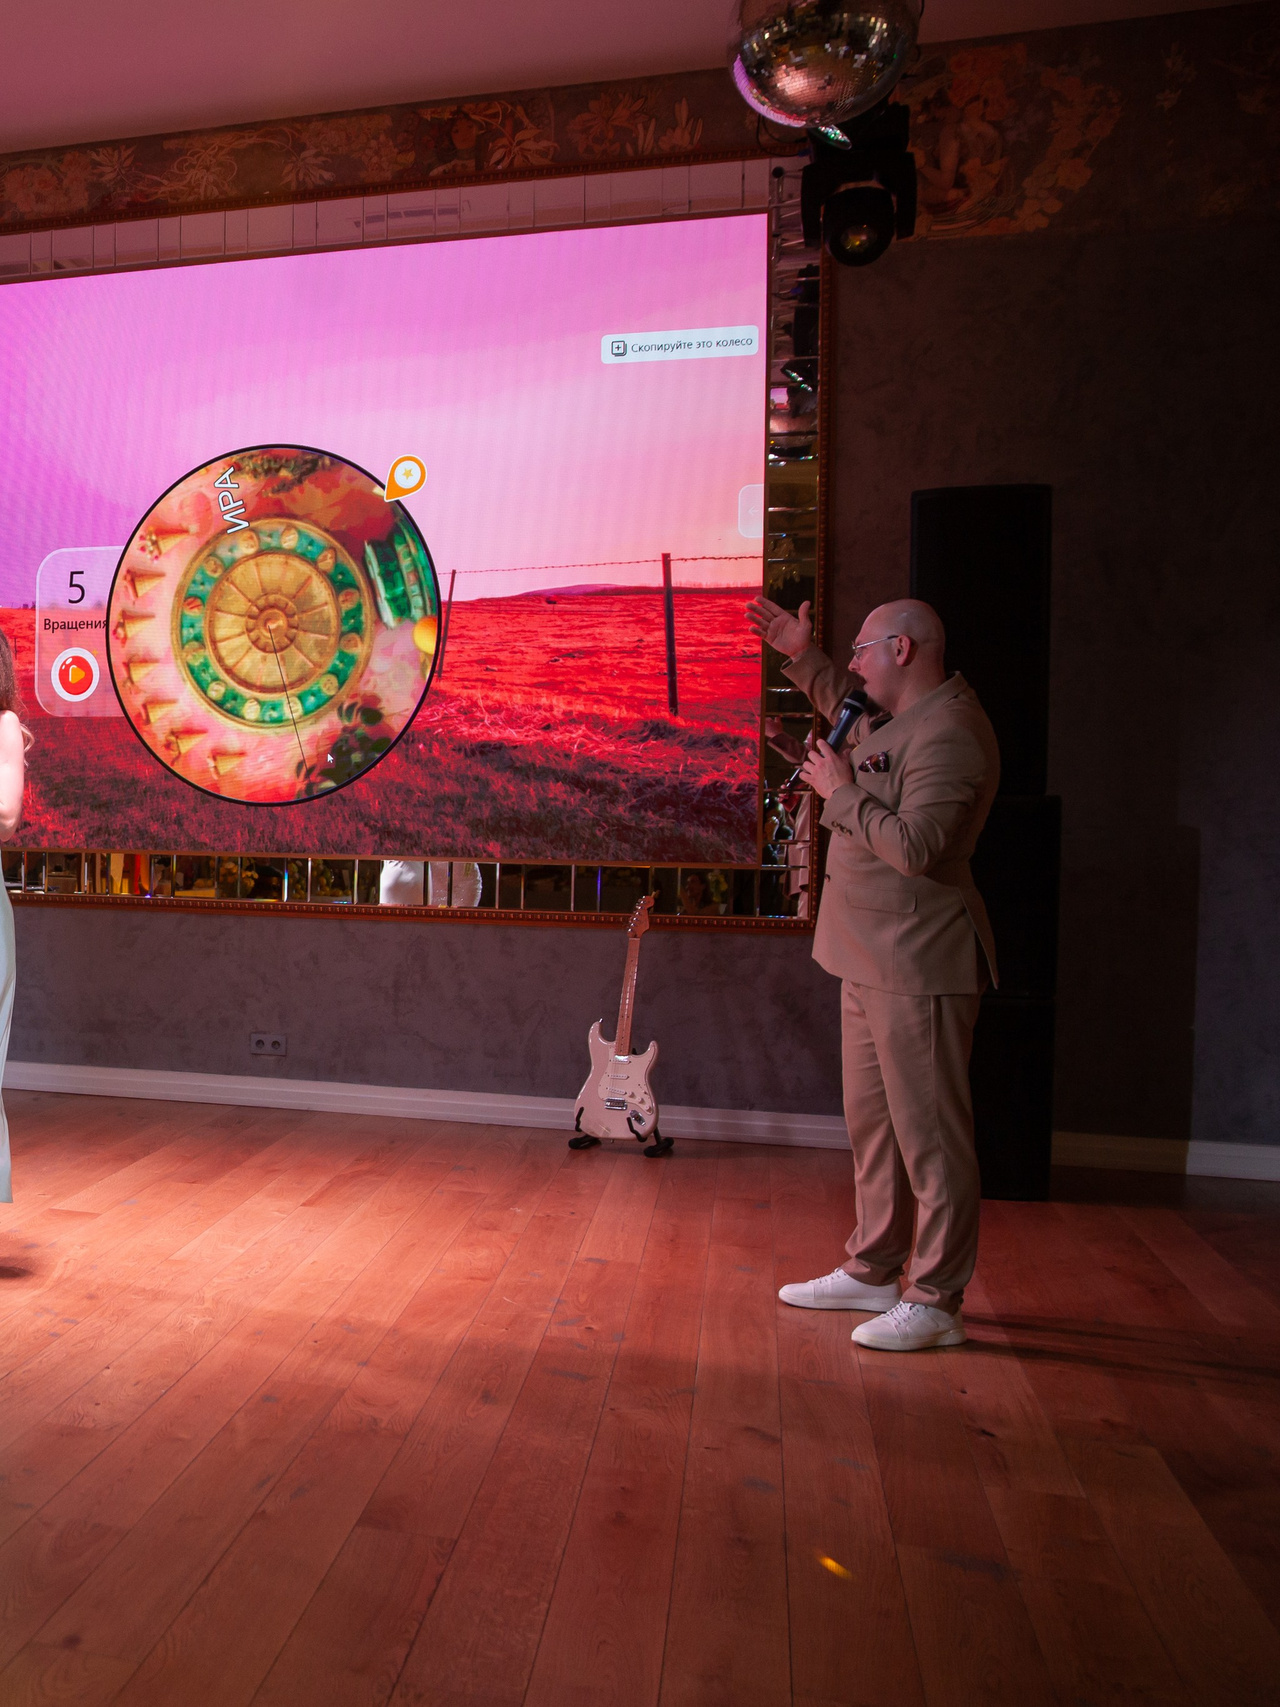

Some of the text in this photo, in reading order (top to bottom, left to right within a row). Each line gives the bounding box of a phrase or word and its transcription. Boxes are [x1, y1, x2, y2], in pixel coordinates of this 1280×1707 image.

[631, 336, 753, 354] Скопируйте это колесо
[214, 466, 250, 535] ИРА
[67, 570, 86, 604] 5
